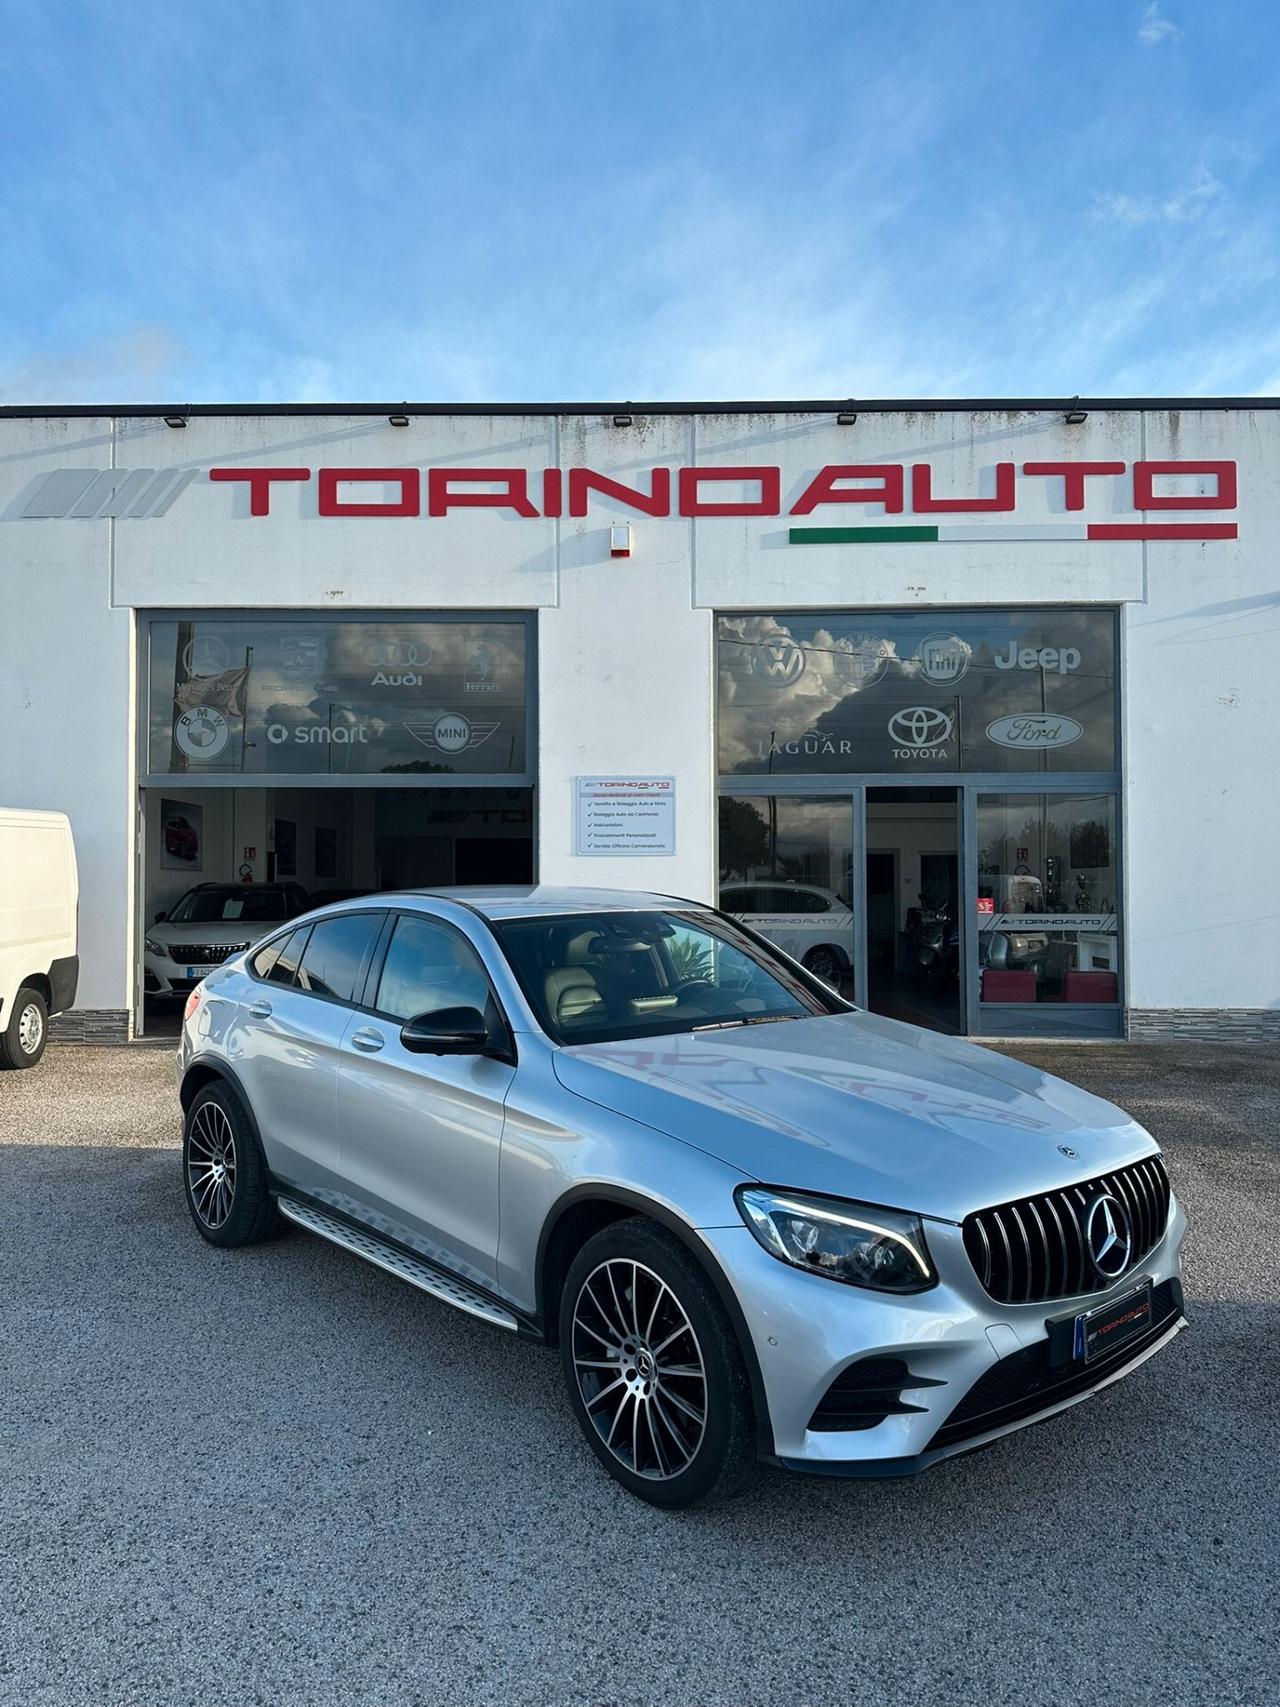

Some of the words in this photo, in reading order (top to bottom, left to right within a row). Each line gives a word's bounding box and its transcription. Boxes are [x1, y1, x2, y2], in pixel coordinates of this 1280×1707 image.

[209, 460, 1238, 518] TORINOAUTO
[994, 640, 1081, 675] Jeep
[371, 671, 423, 686] Audi
[180, 708, 225, 727] BMW
[294, 722, 368, 744] smart
[437, 728, 466, 739] MINI
[1006, 718, 1062, 741] Ford
[757, 739, 852, 755] JAGUAR
[891, 748, 948, 760] TOYOTA
